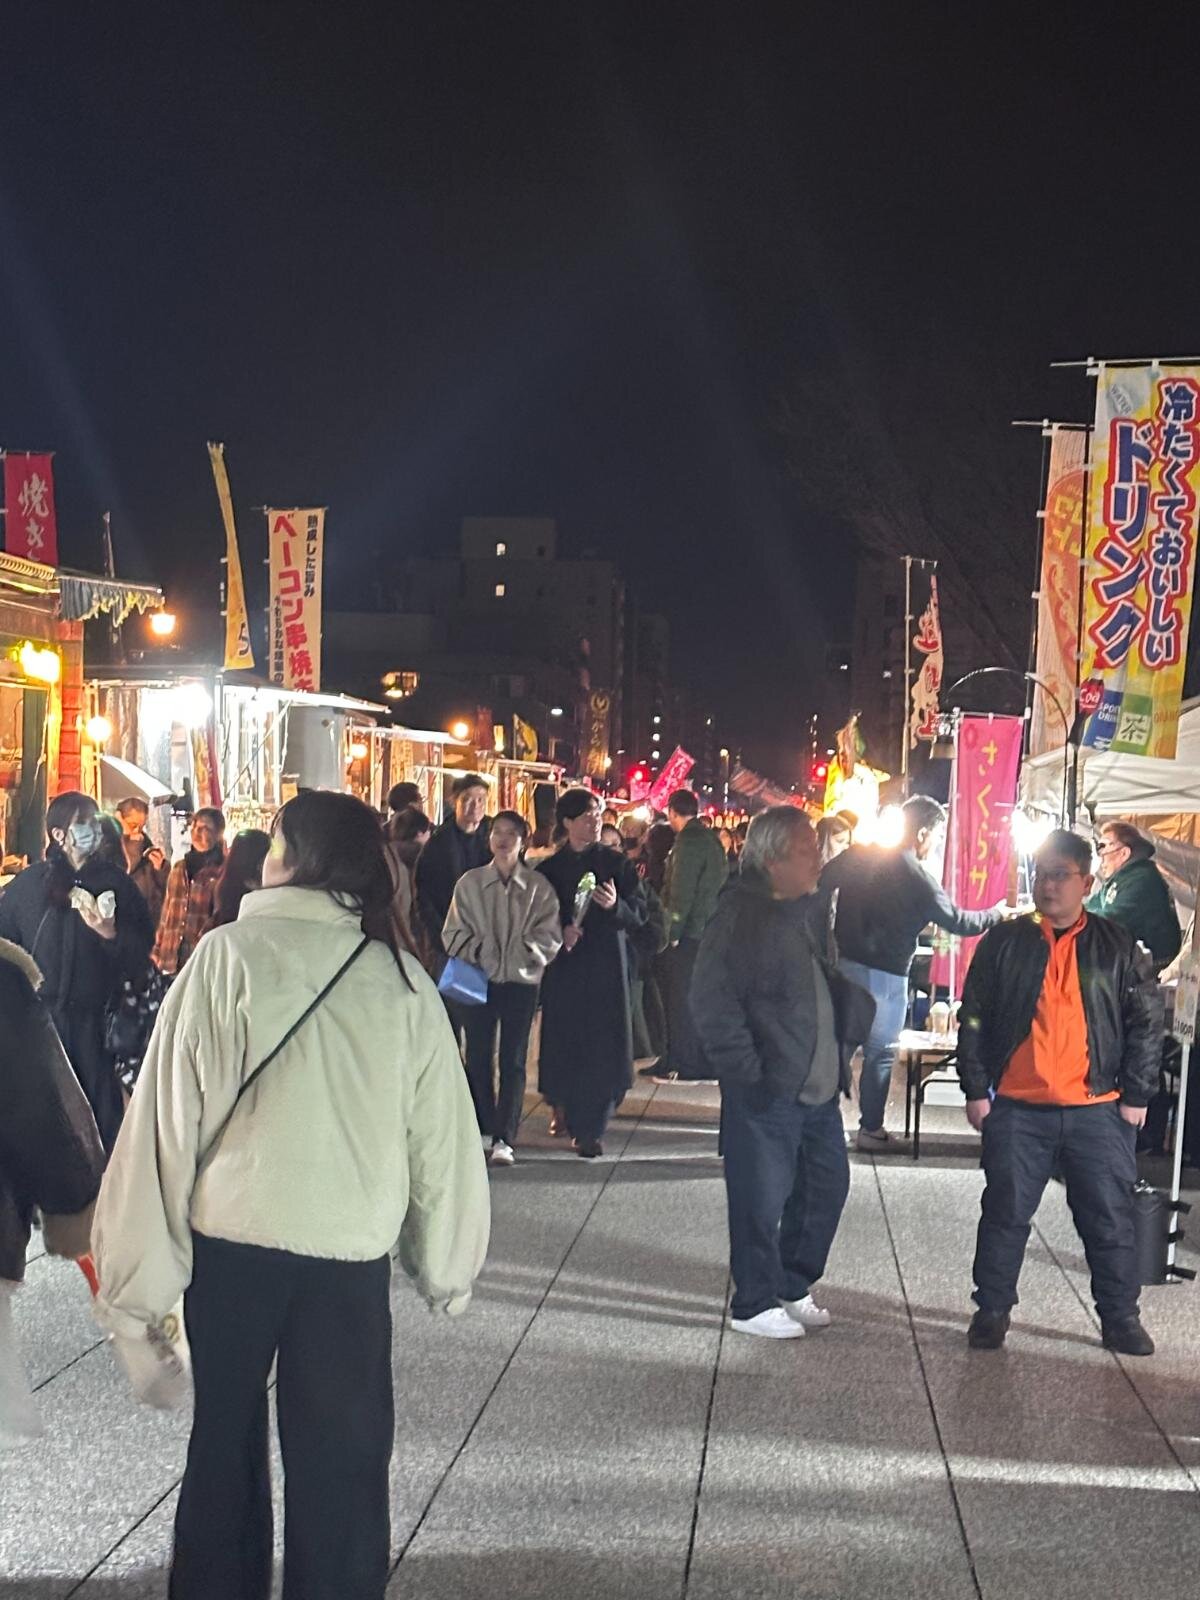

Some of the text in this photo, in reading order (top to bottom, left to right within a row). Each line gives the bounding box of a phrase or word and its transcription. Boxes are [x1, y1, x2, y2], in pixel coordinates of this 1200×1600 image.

[1110, 383, 1132, 415] WATER
[1097, 421, 1155, 667] ドリンク
[1145, 383, 1196, 665] 冷たくておいしい
[1121, 715, 1147, 741] 茶
[969, 739, 998, 901] さくらサ
